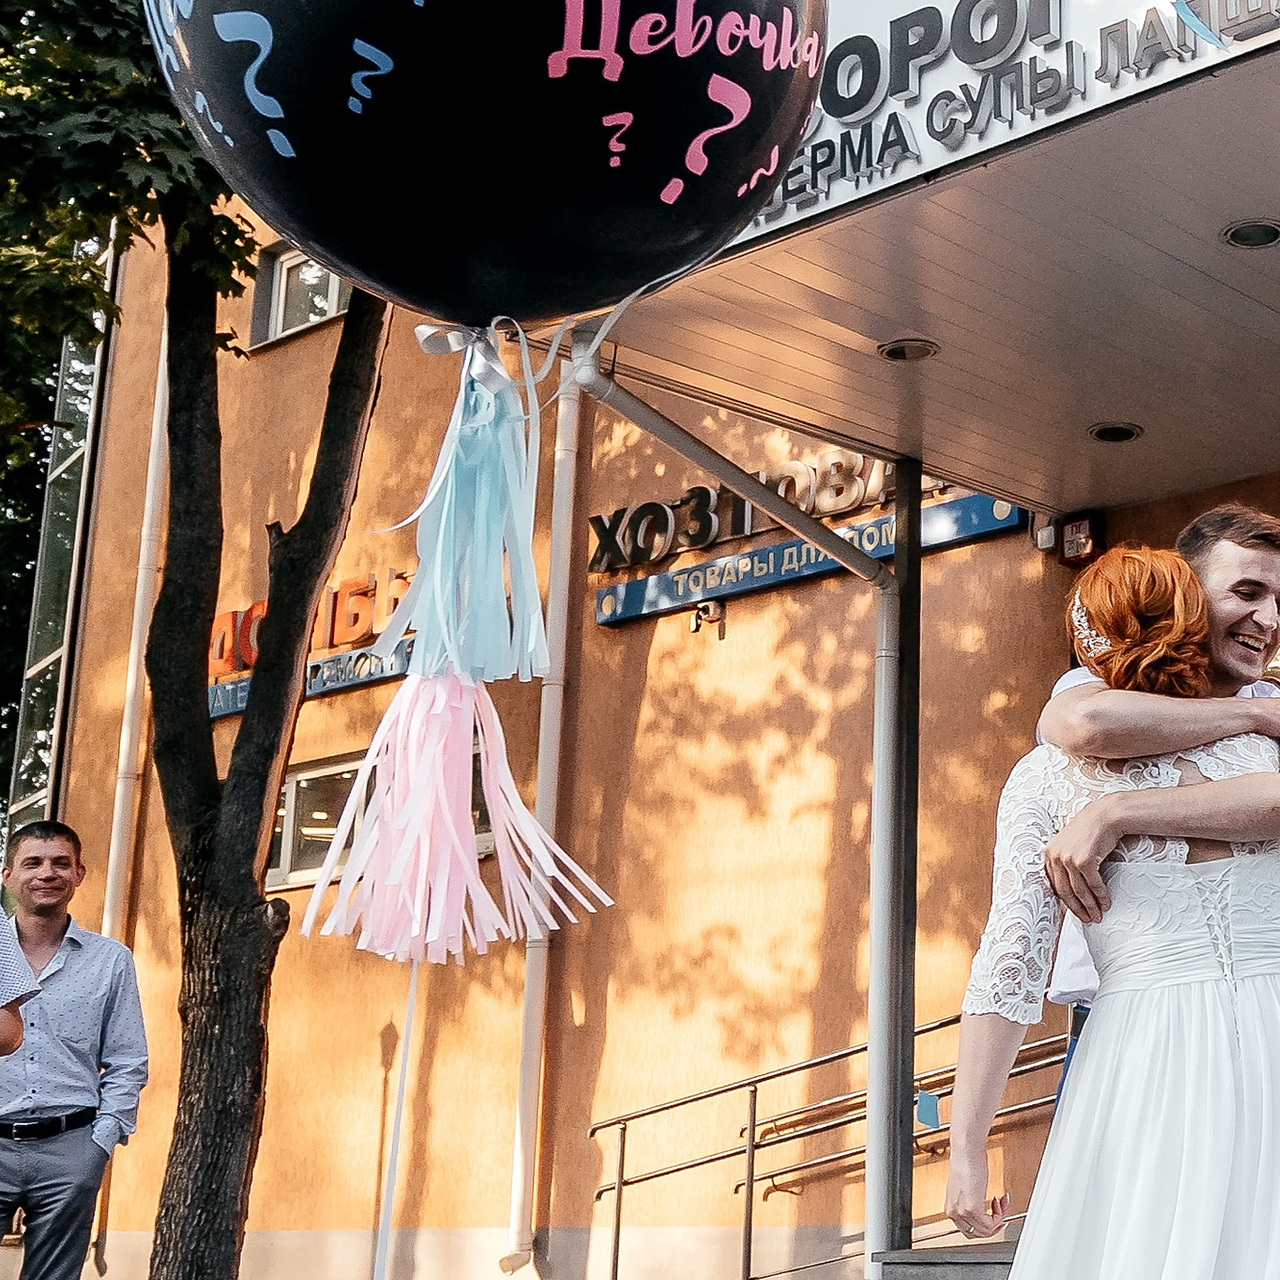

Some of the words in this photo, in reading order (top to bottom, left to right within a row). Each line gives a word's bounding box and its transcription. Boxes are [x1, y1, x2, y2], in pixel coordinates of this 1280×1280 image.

[776, 111, 920, 206] ЕРМА
[926, 40, 1086, 144] СУПЫ
[674, 546, 774, 597] ТОВАРЫ
[843, 520, 898, 552] ДОМ
